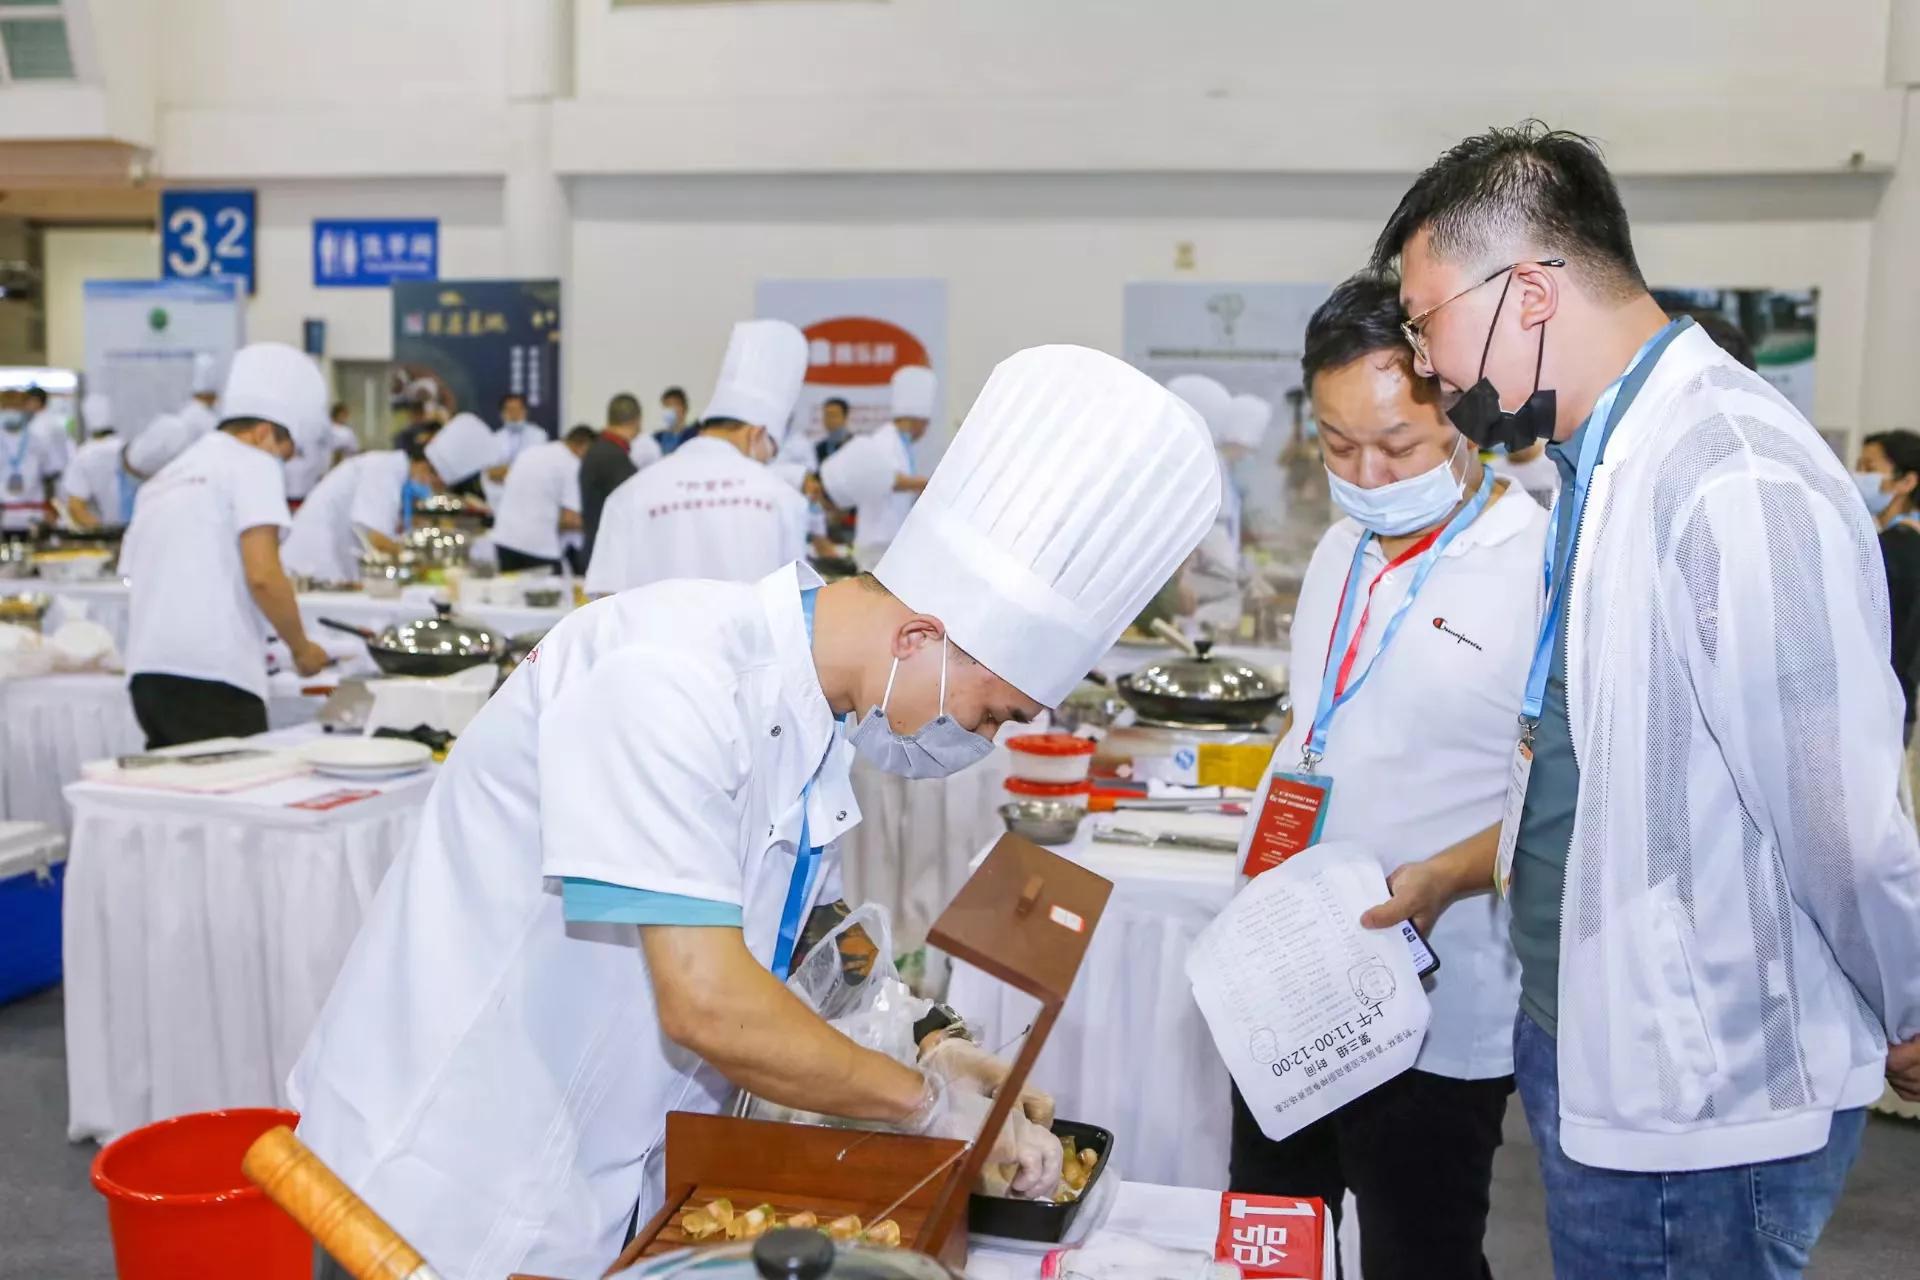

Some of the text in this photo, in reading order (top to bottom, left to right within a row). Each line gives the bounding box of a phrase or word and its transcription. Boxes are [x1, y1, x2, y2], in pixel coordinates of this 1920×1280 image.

[1356, 1001, 1384, 1029] 上午
[1272, 1021, 1355, 1077] 11:00-12:00
[1304, 1032, 1372, 1077] 第三组 时间
